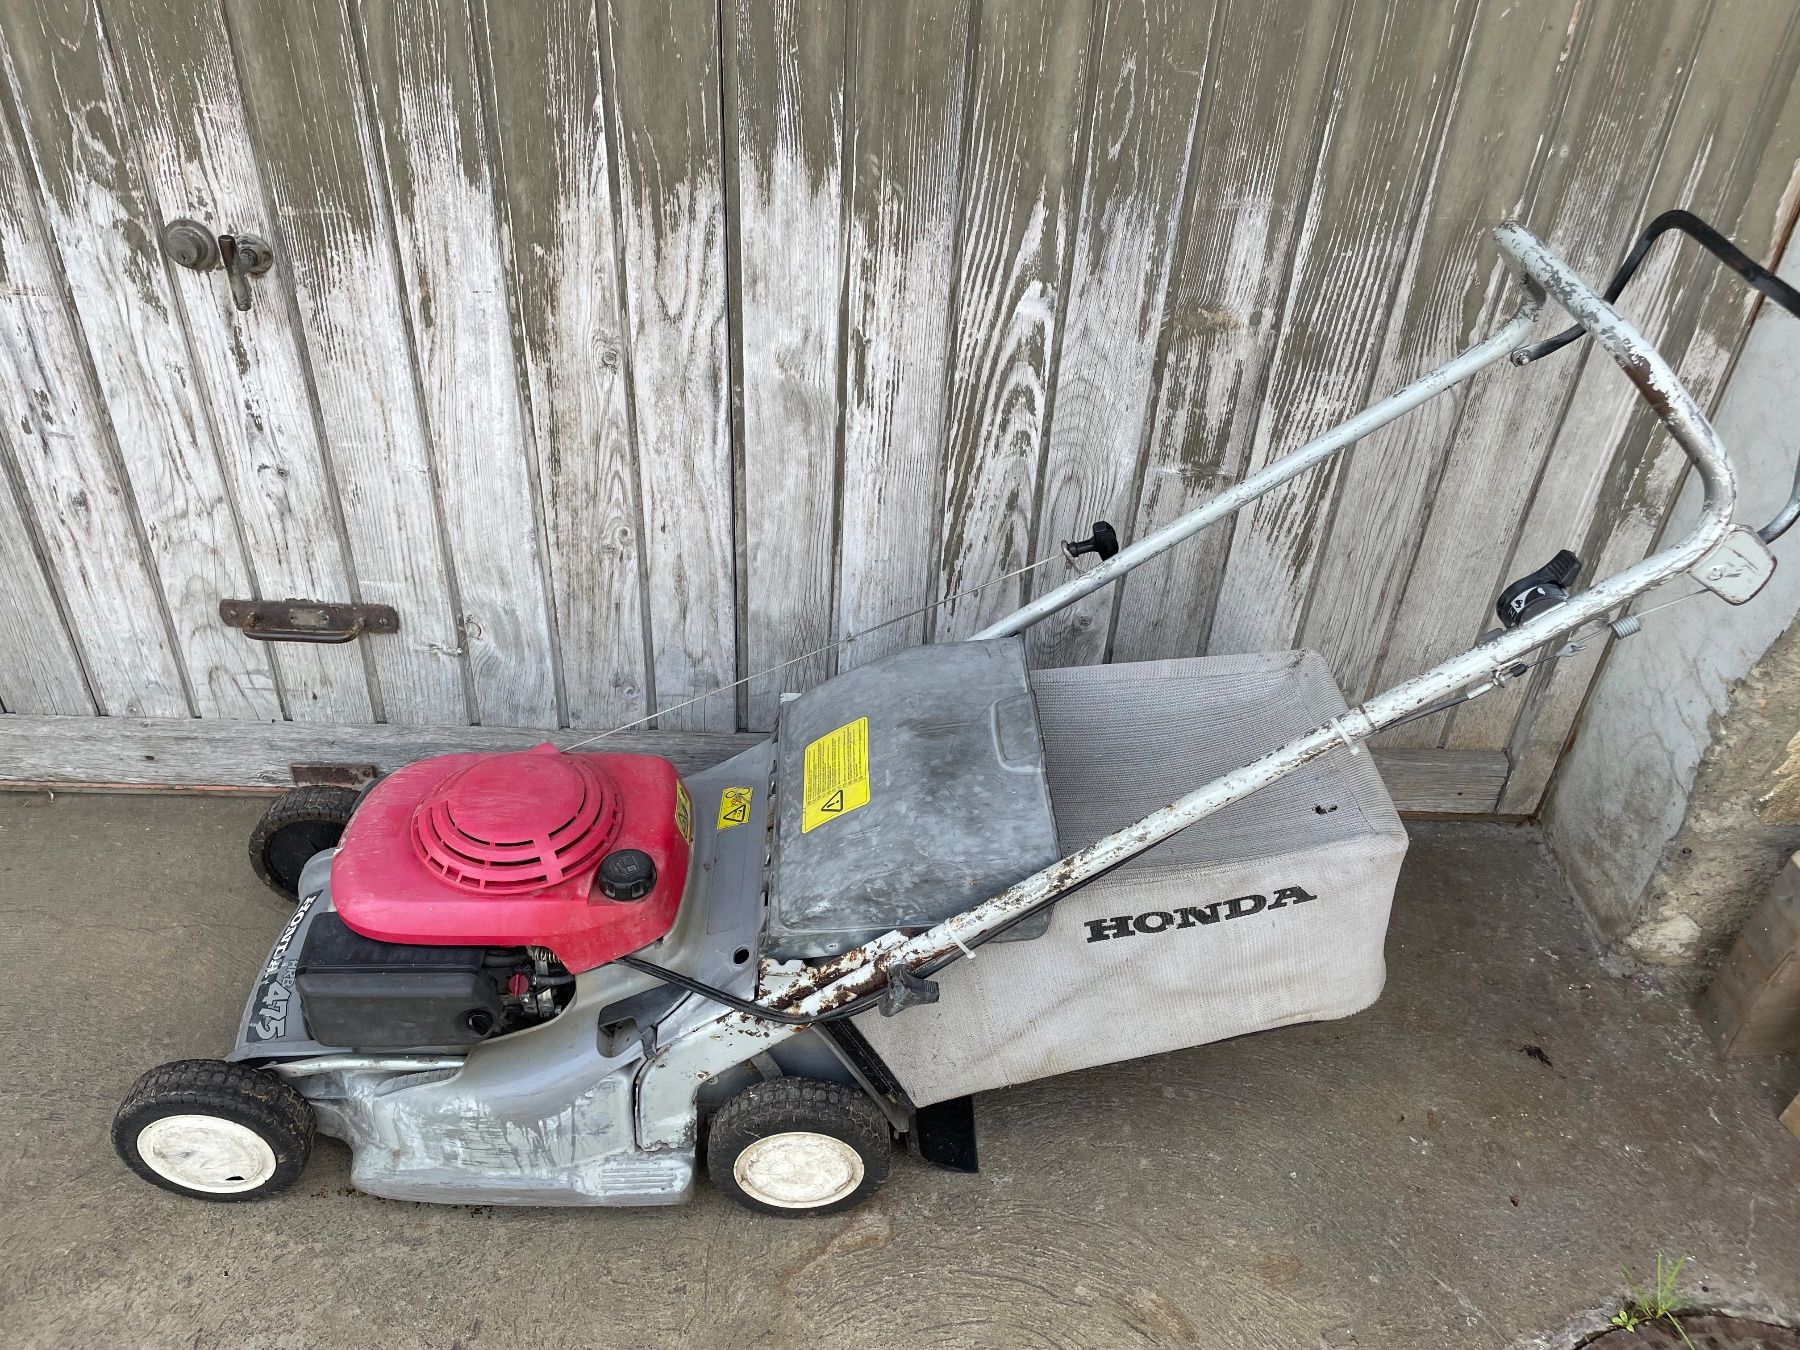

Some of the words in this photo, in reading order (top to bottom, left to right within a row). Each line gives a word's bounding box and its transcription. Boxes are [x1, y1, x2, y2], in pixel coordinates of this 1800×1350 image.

[264, 895, 317, 979] HONDA
[1084, 885, 1318, 943] HONDA
[282, 958, 299, 988] HRB
[256, 980, 292, 1041] 475
